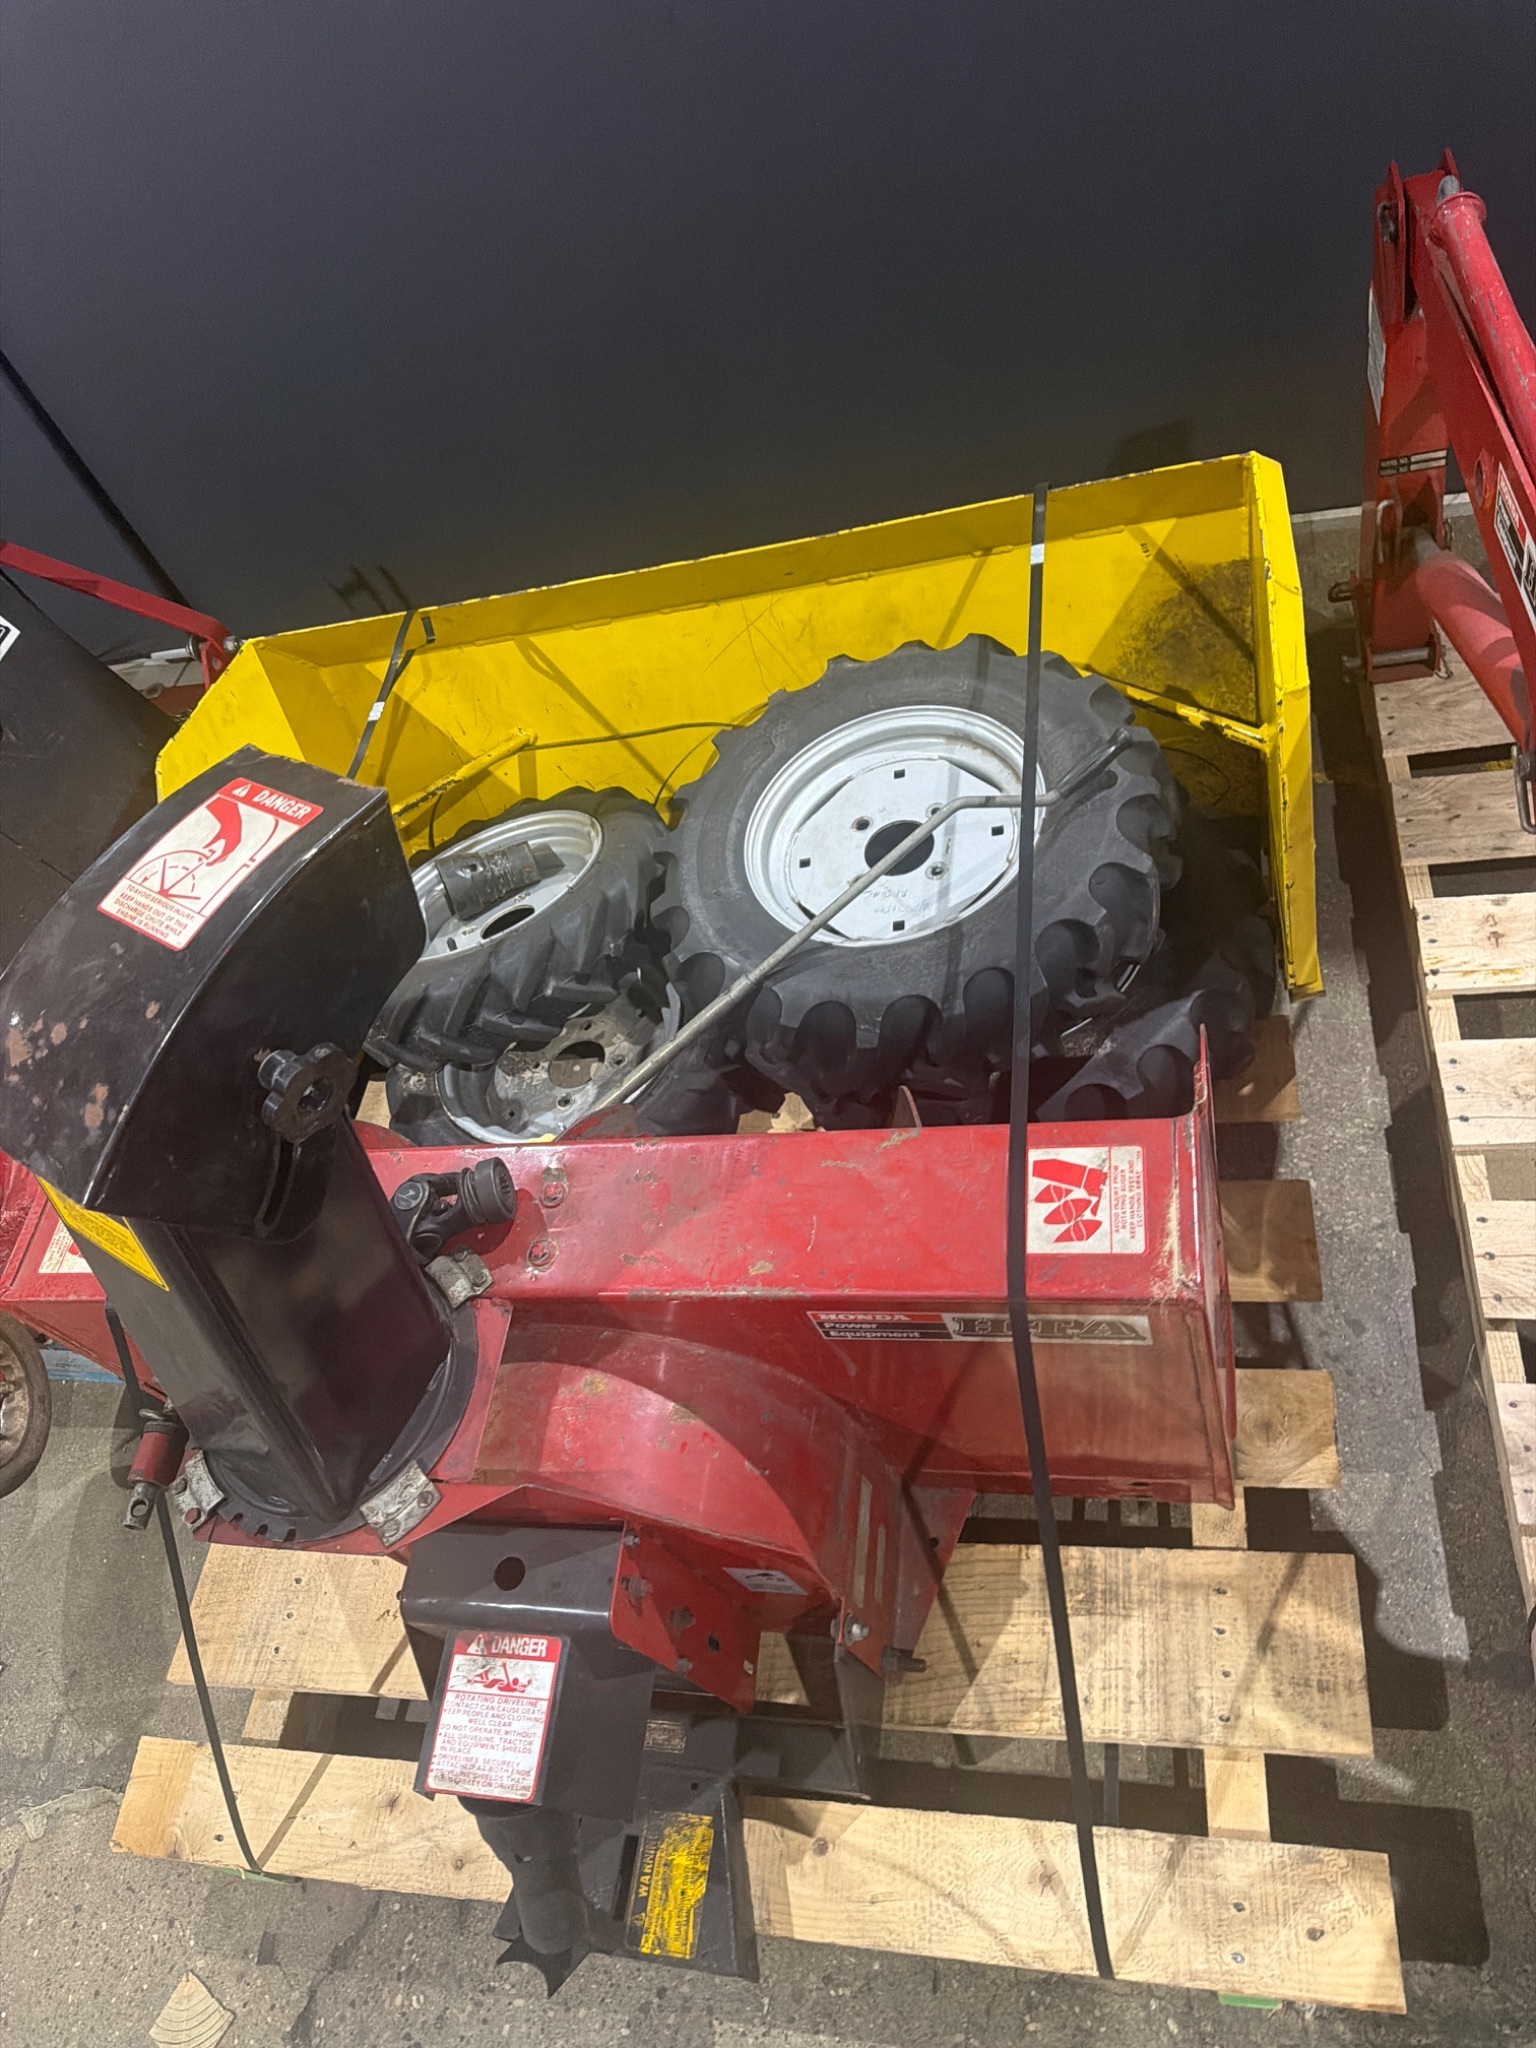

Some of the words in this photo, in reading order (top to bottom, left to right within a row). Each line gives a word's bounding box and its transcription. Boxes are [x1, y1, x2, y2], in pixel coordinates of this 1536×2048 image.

[252, 789, 311, 820] DANGER
[118, 892, 134, 903] KEEP
[132, 899, 153, 912] HANDS
[151, 908, 166, 918] OUT
[164, 914, 174, 922] OF
[173, 919, 188, 929] THIS
[149, 895, 175, 911] SERIOUS
[113, 898, 145, 917] DISCHARGE
[143, 913, 164, 927] CHUTE
[163, 923, 183, 936] WHILE
[115, 908, 137, 922] ENGINE
[142, 921, 170, 938] RUNNING
[490, 1635, 548, 1657] DANGER
[445, 1700, 478, 1709] CONTACT
[479, 1703, 495, 1711] CAN
[496, 1705, 518, 1713] CAUSE
[520, 1707, 545, 1716] DEATH
[454, 1693, 495, 1703] ROTATING
[497, 1697, 538, 1707] DRIVELINE
[443, 1707, 461, 1715] KEEP
[462, 1709, 489, 1718] PEOPLE
[506, 1714, 544, 1723] CLOTHING
[467, 1717, 486, 1725] WELL
[488, 1719, 512, 1727] CLEAR
[441, 1738, 456, 1746] AND
[457, 1740, 499, 1750] EQUIPMENT
[501, 1744, 532, 1754] SHIELDS
[498, 1737, 533, 1746] TRACTOR
[448, 1746, 471, 1754] PLACE
[436, 1760, 475, 1770] ATTACHED
[488, 1766, 509, 1774] BOTH
[510, 1768, 531, 1776] ENDS
[437, 1753, 478, 1763] DRIVELINES
[482, 1758, 519, 1768] SECURELY
[494, 1781, 531, 1792] DRIVELINE
[506, 1776, 525, 1784] THAT
